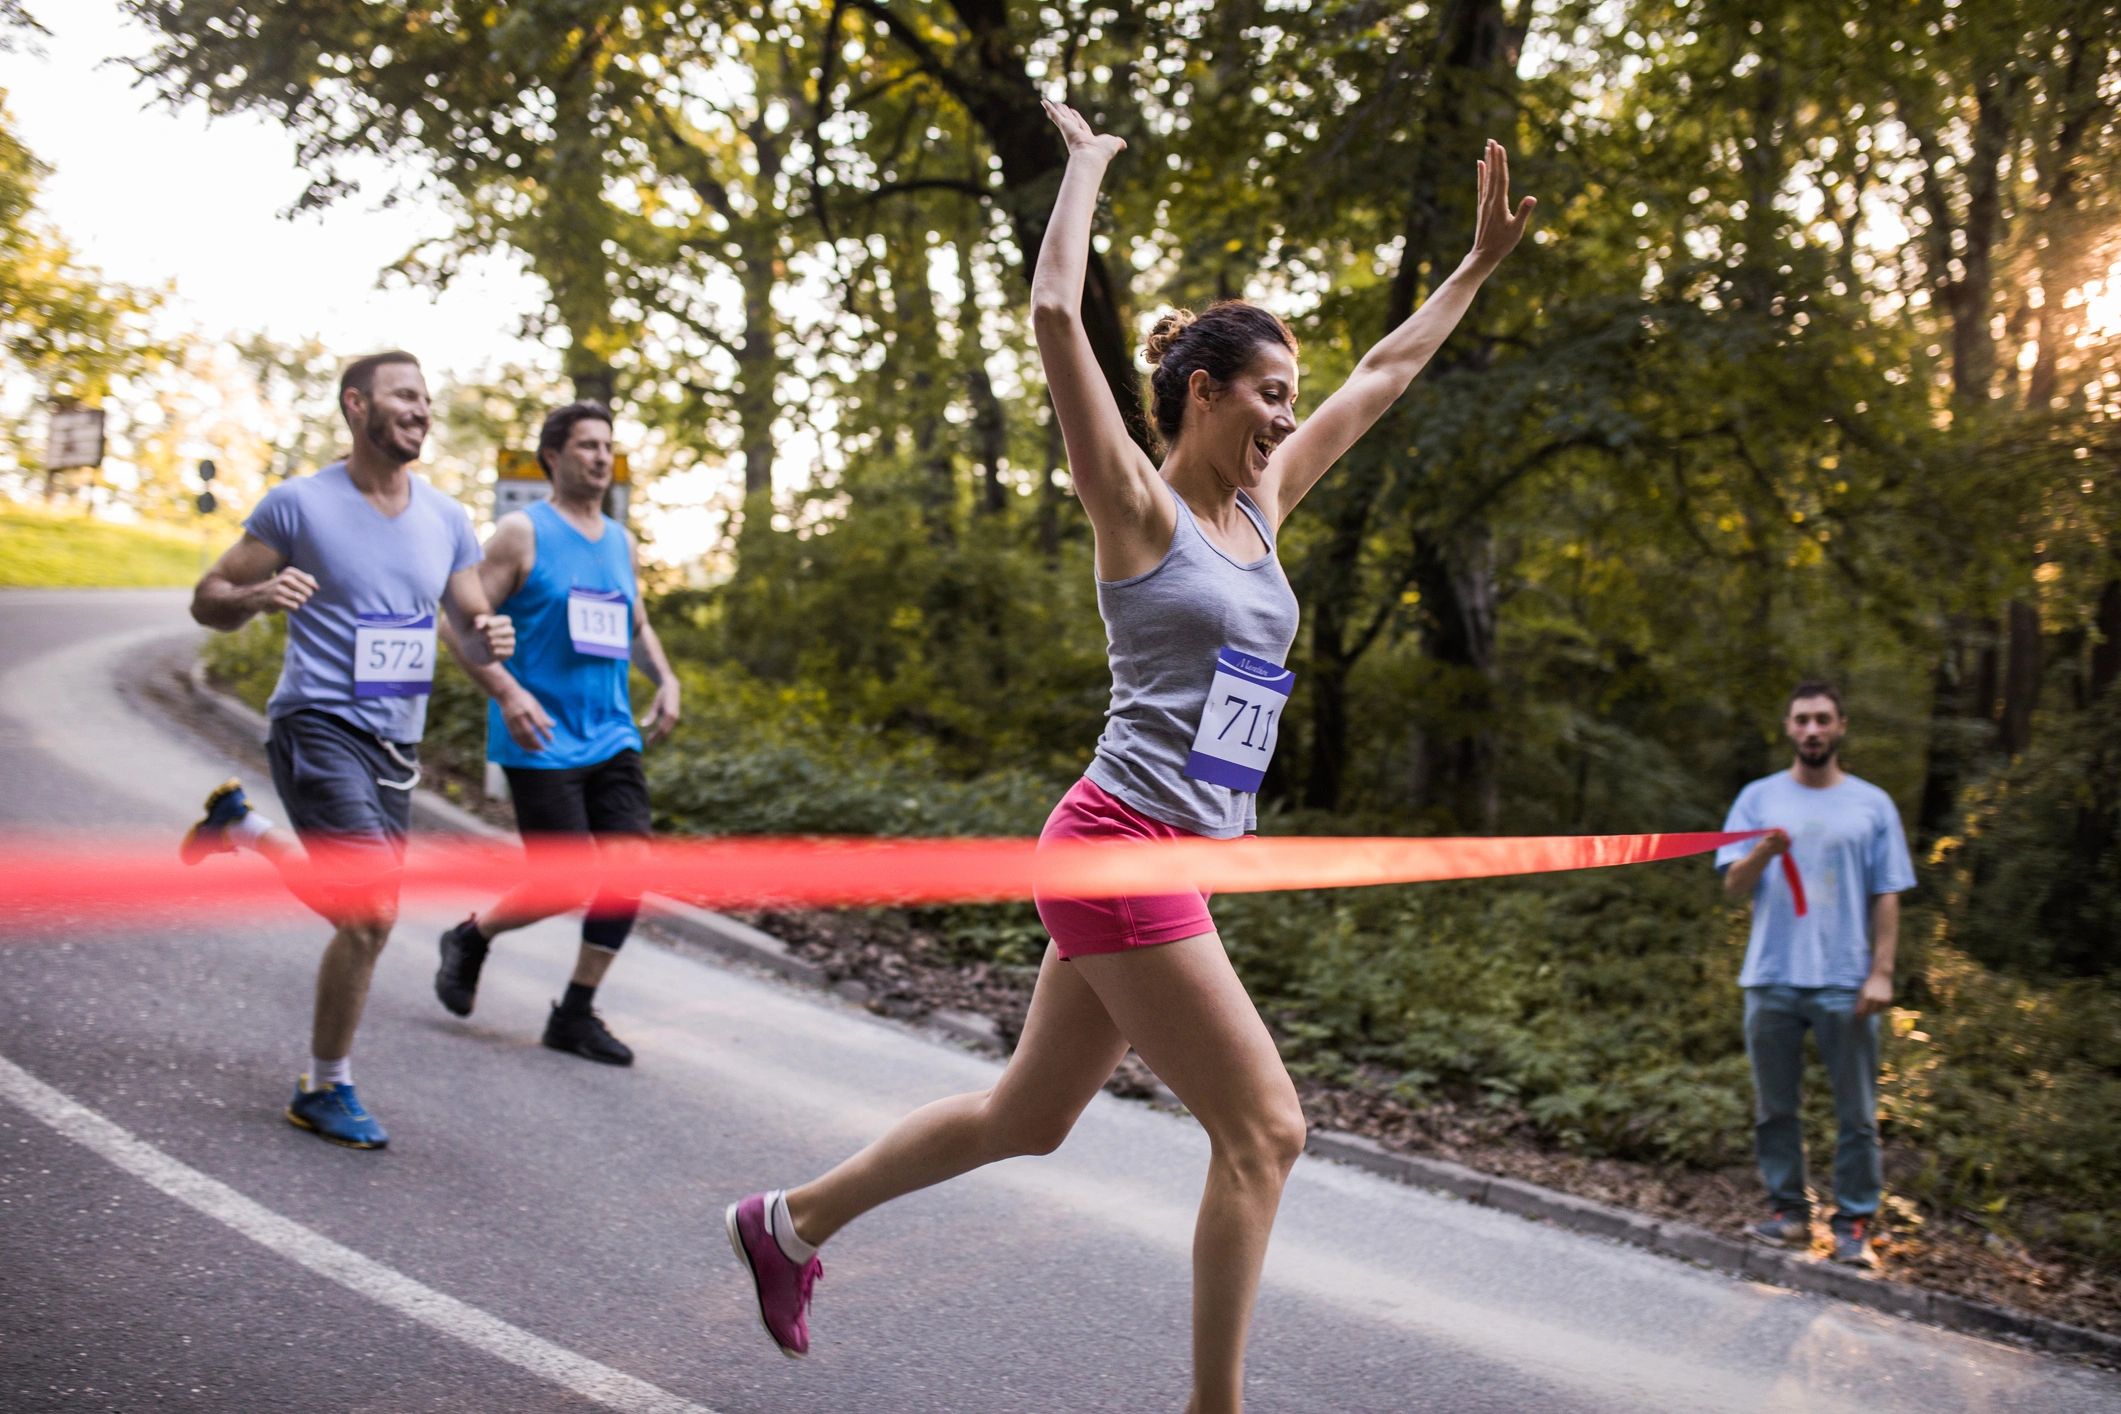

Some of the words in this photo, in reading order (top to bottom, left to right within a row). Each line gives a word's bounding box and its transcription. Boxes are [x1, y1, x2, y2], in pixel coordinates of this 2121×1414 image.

[580, 608, 616, 636] 131
[370, 640, 424, 671] 572
[1217, 695, 1275, 752] 711
